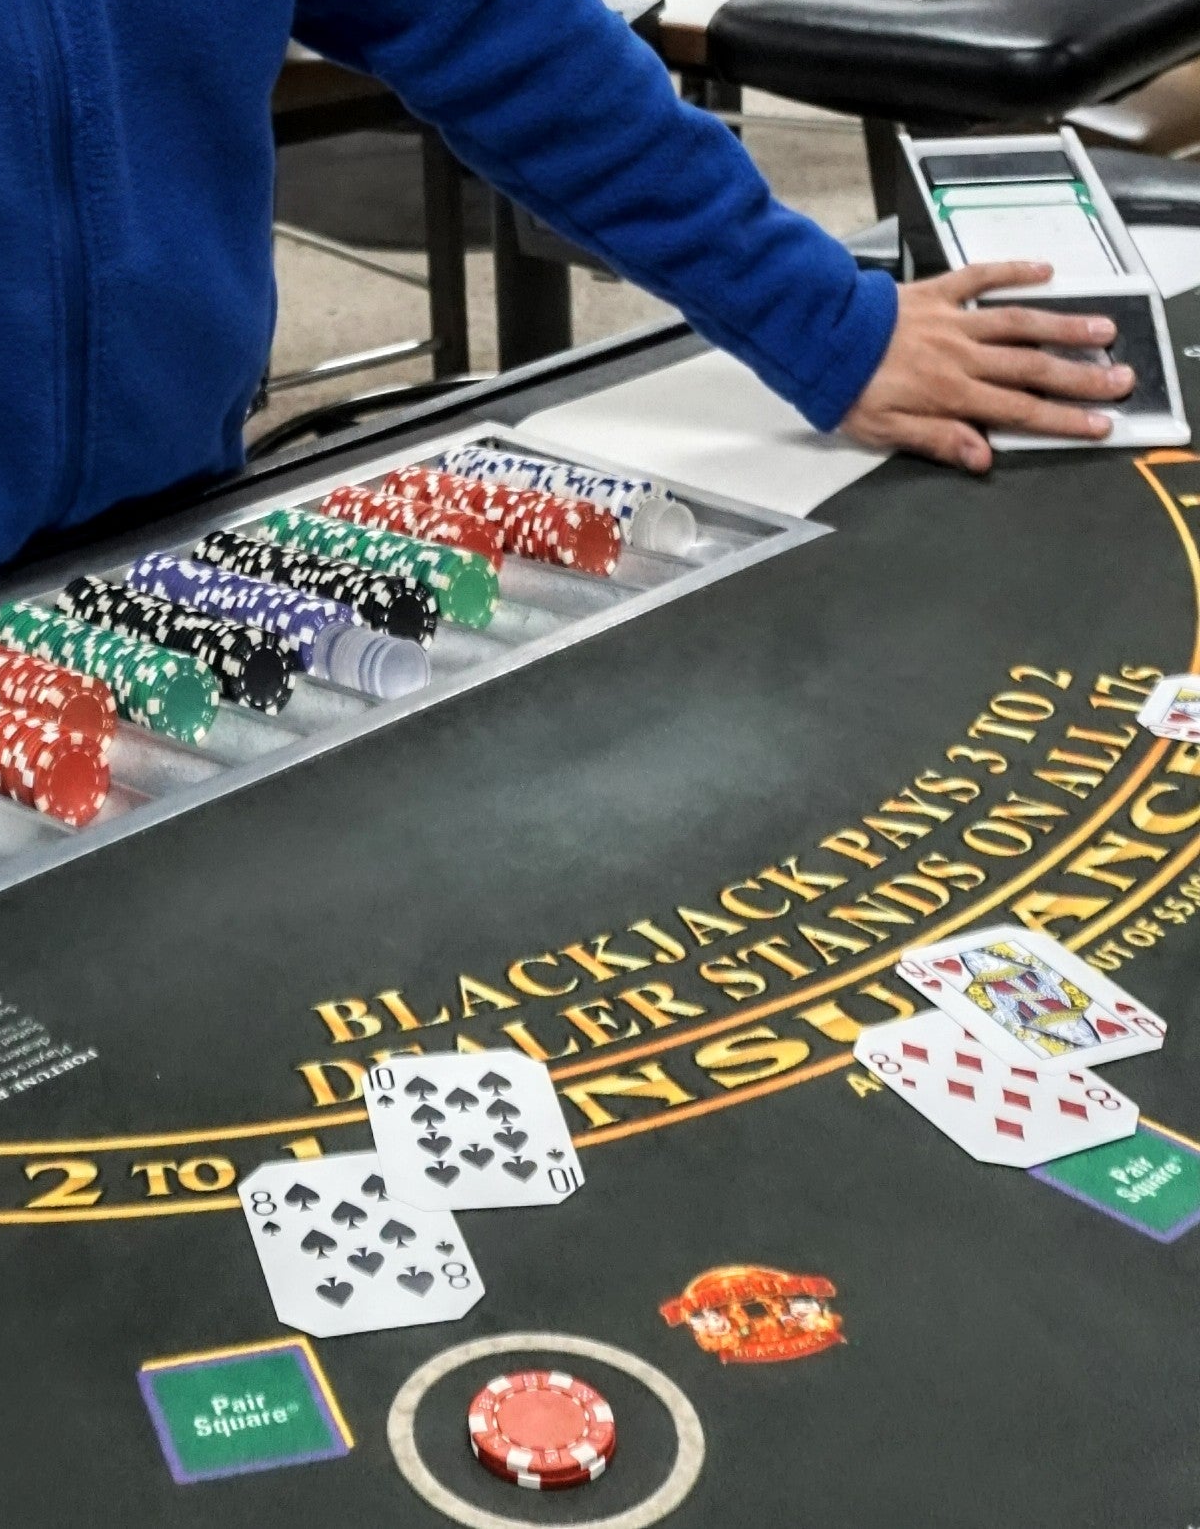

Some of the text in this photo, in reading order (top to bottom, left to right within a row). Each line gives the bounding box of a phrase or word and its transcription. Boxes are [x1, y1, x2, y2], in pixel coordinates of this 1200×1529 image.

[311, 665, 1073, 1044] BLACKJACK PAYS 3 TO 2
[297, 980, 707, 1107] DLER
[700, 852, 986, 1001] STANDS
[963, 790, 1070, 858] ON
[1032, 724, 1138, 799] ALL
[1122, 916, 1166, 947] OF
[869, 1053, 903, 1074] 8
[367, 1067, 395, 1092] 10
[1085, 1088, 1122, 1110] 8
[25, 1159, 101, 1209] 2
[132, 1157, 236, 1197] TO
[547, 1166, 580, 1194] 10
[1109, 1156, 1154, 1184] Pair
[250, 1191, 278, 1217] 8
[441, 1262, 472, 1290] 8
[211, 1392, 265, 1416] Pair
[194, 1407, 288, 1437] Square
